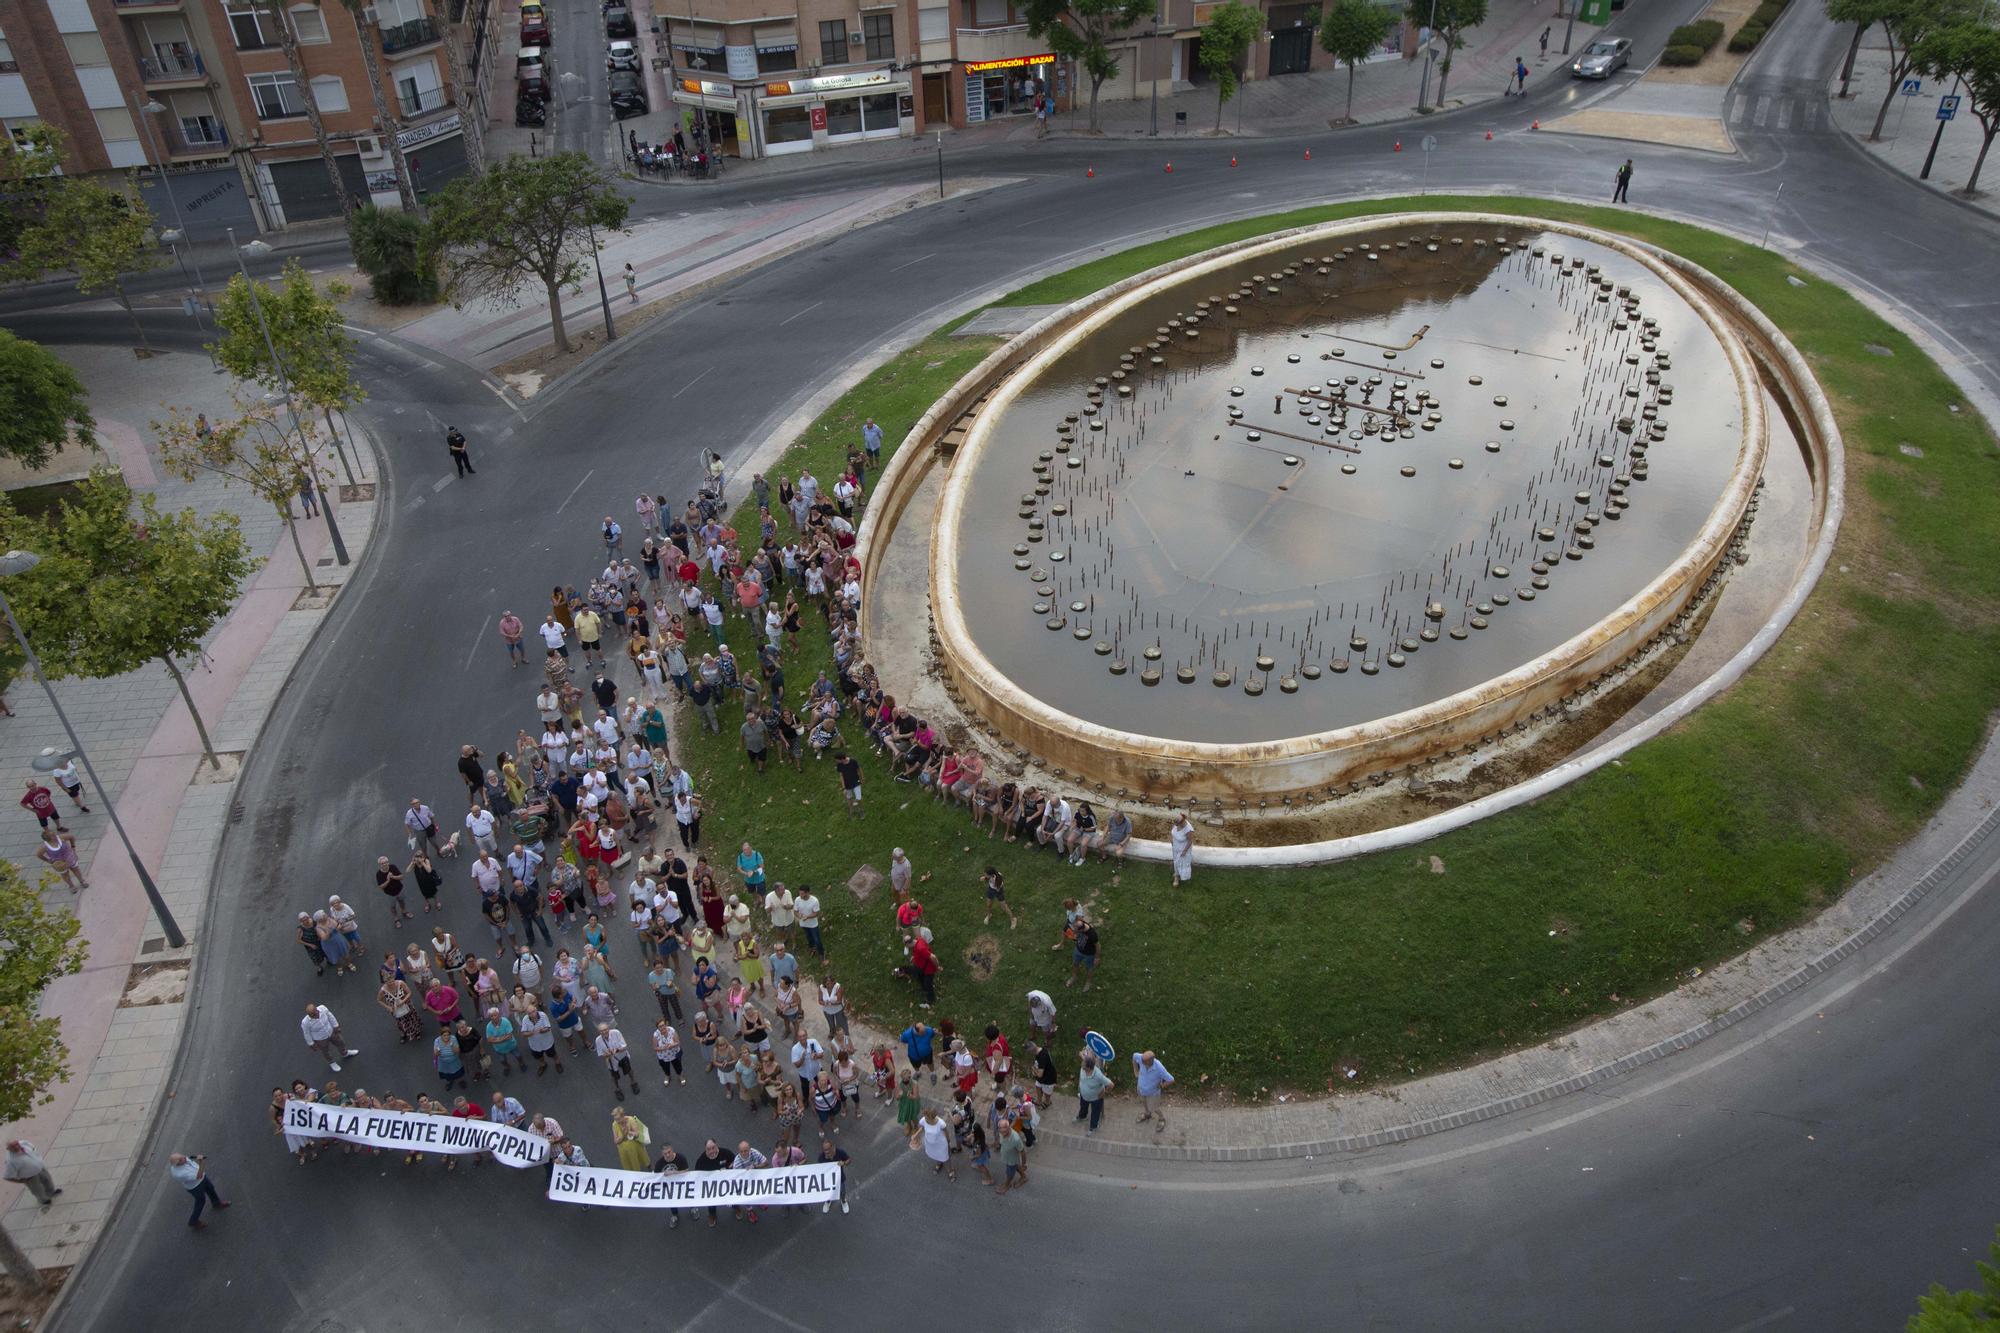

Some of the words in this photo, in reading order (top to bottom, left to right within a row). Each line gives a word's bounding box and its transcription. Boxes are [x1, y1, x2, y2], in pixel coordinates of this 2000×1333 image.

[971, 59, 1024, 71] ALIMENTACIÓN
[1030, 56, 1055, 65] BAZAR
[768, 84, 788, 92] DELTA
[831, 76, 852, 84] Golosa
[186, 181, 235, 212] IMPRENTA
[290, 1107, 313, 1129] ¡SÍ
[317, 1112, 329, 1132] A
[334, 1114, 359, 1136] LA
[364, 1117, 438, 1143] FUENTE
[441, 1124, 544, 1162] MUNICIPAL!
[555, 1171, 581, 1193] ¡SÍ
[584, 1177, 597, 1196] A
[602, 1178, 624, 1199] LA
[627, 1180, 696, 1200] FUENTE
[701, 1171, 837, 1199] MONUMENTAL!
